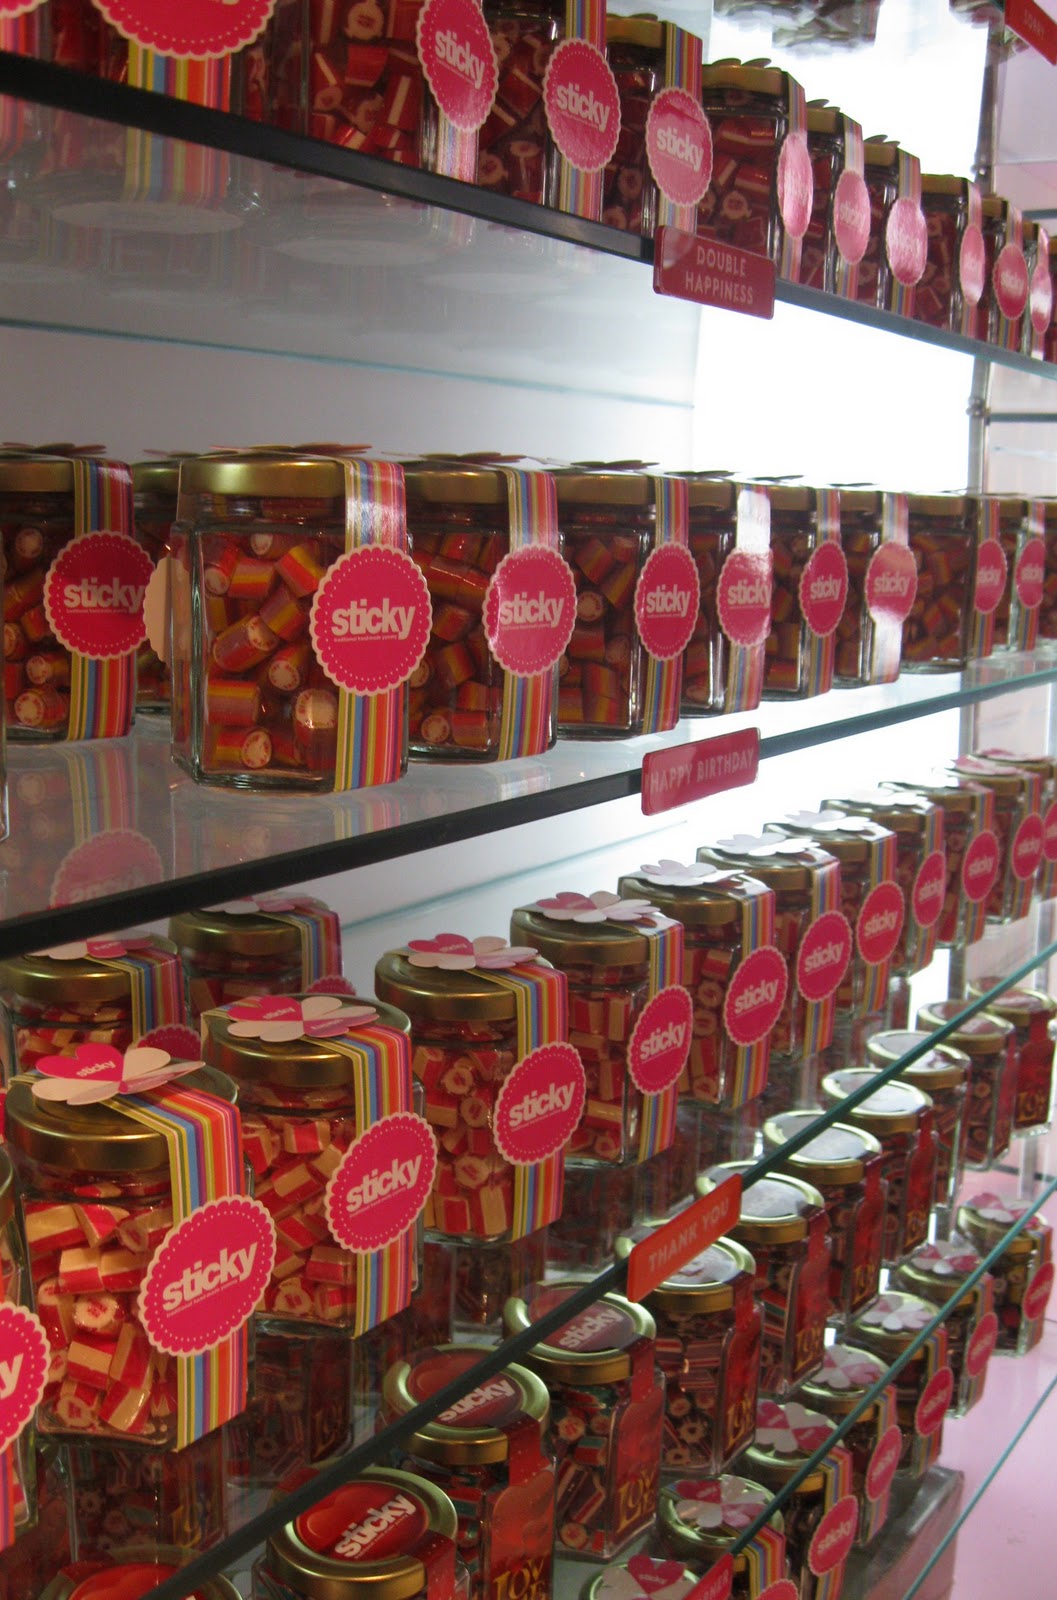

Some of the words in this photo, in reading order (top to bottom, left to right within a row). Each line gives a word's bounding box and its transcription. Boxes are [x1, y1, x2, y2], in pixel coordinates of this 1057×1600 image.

[435, 30, 485, 89] sticky
[556, 84, 610, 133] sticky
[657, 127, 704, 172] sticky
[697, 246, 747, 278] DOUBLE
[685, 271, 754, 306] HAPPINESS
[64, 577, 145, 614] sticky
[646, 584, 692, 616] sticky
[810, 575, 842, 601] sticky
[873, 572, 910, 597] sticky
[331, 598, 416, 640] sticky
[500, 591, 565, 625] sticky
[650, 768, 692, 796] HAPPY
[697, 749, 755, 782] BIRTHDAY
[864, 909, 898, 938] sticky
[804, 941, 844, 973] sticky
[734, 979, 780, 1014] sticky
[640, 1022, 687, 1060] sticky
[76, 1060, 116, 1077] sticky
[509, 1081, 576, 1127] sticky
[346, 1154, 422, 1213] sticky
[648, 1222, 698, 1273] THANK
[702, 1197, 729, 1233] YOU
[162, 1242, 258, 1311] sticky
[559, 1308, 624, 1349] sticky
[334, 1493, 416, 1558] sticky
